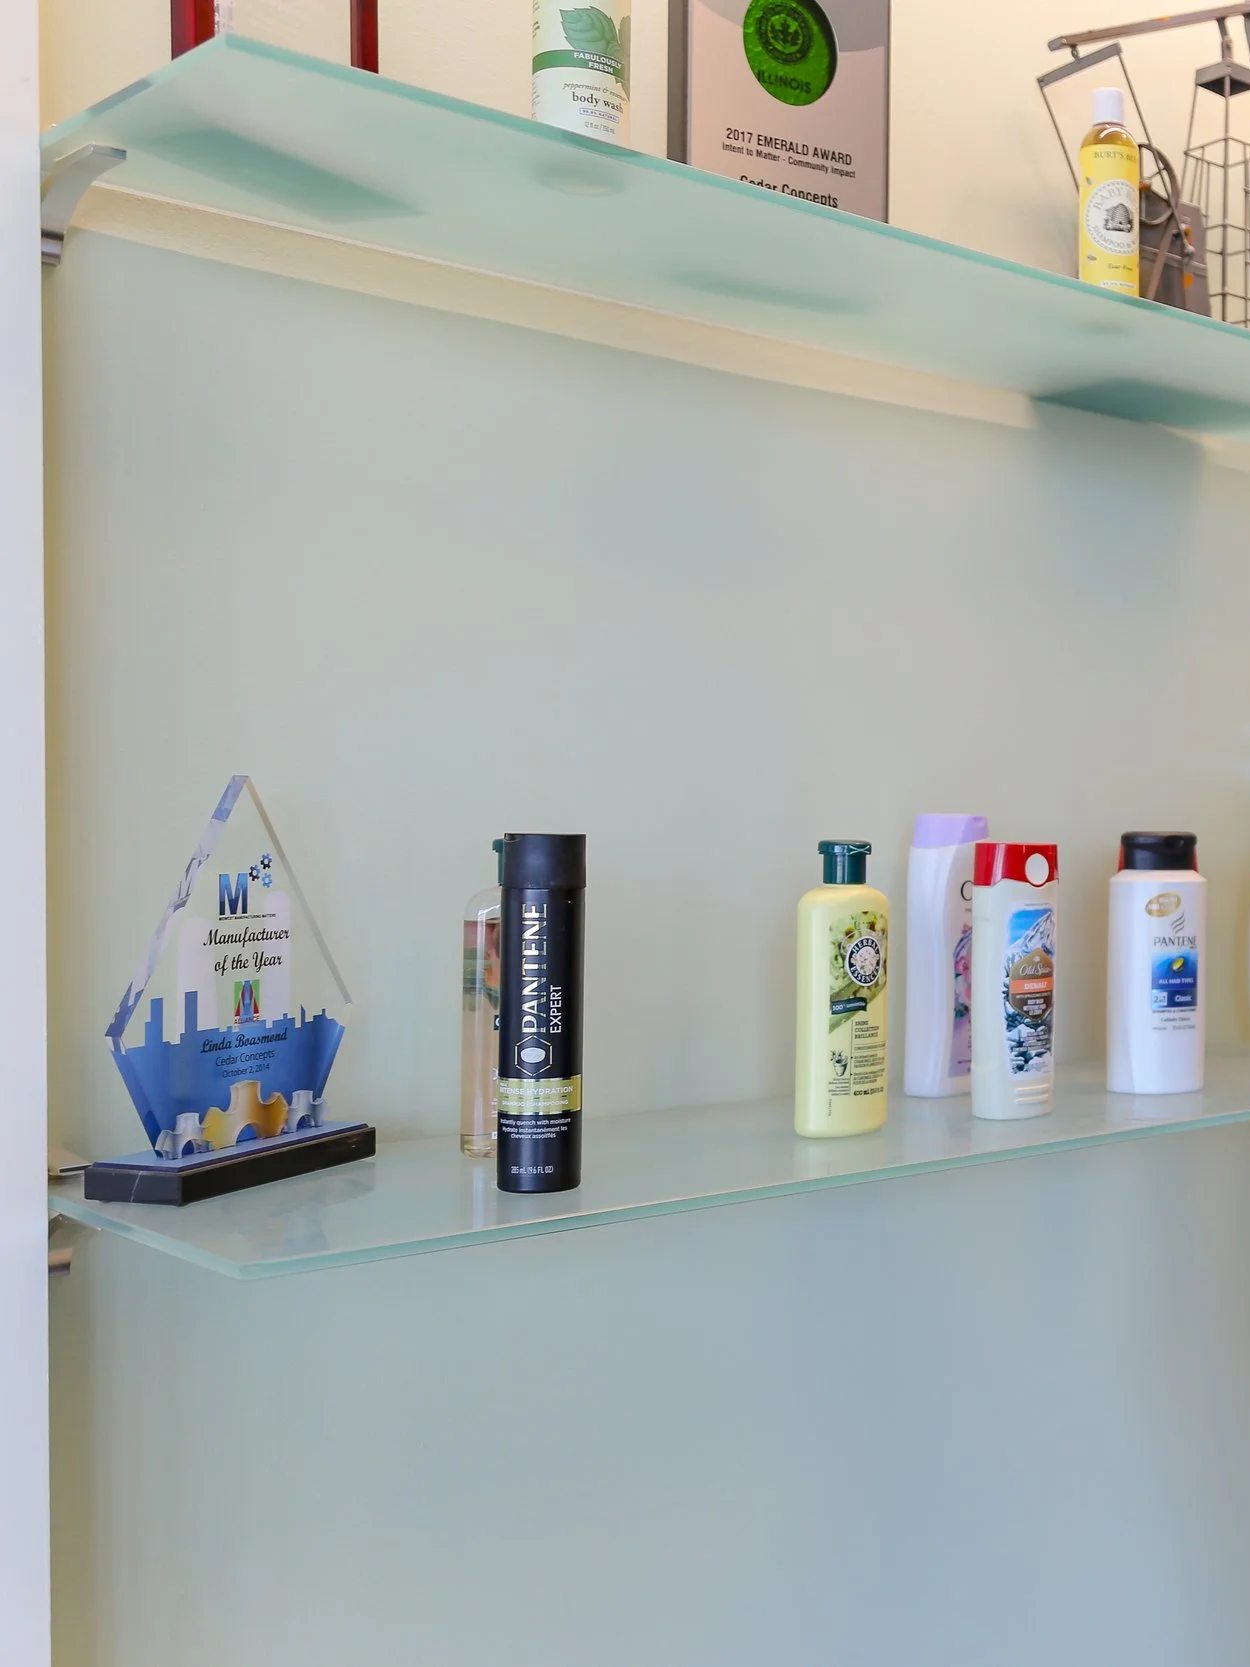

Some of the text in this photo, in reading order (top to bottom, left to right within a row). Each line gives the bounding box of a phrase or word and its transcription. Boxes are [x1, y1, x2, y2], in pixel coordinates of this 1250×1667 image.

[574, 52, 622, 69] FABULOUSLY
[588, 61, 614, 74] FRESH
[562, 82, 601, 92] peppermint
[757, 69, 812, 95] ILLINOIS
[572, 92, 624, 114] body wash
[726, 127, 853, 166] 2017 EMERALD AWARD
[722, 141, 744, 155] Intent
[746, 147, 754, 157] to
[756, 149, 780, 162] Matter
[787, 156, 829, 173] Community
[831, 166, 856, 178] Impact
[219, 873, 249, 915] M
[203, 926, 290, 948] Manufacturer
[1153, 935, 1197, 947] PANTENE
[214, 950, 283, 976] of the Year
[522, 903, 547, 1033] PANTENE
[550, 985, 562, 1034] EXPERT
[200, 1027, 288, 1053] Linda Boasmond
[215, 1050, 275, 1067] Cedar Concepts
[222, 1067, 248, 1079] October
[527, 1086, 574, 1095] HYDRATION
